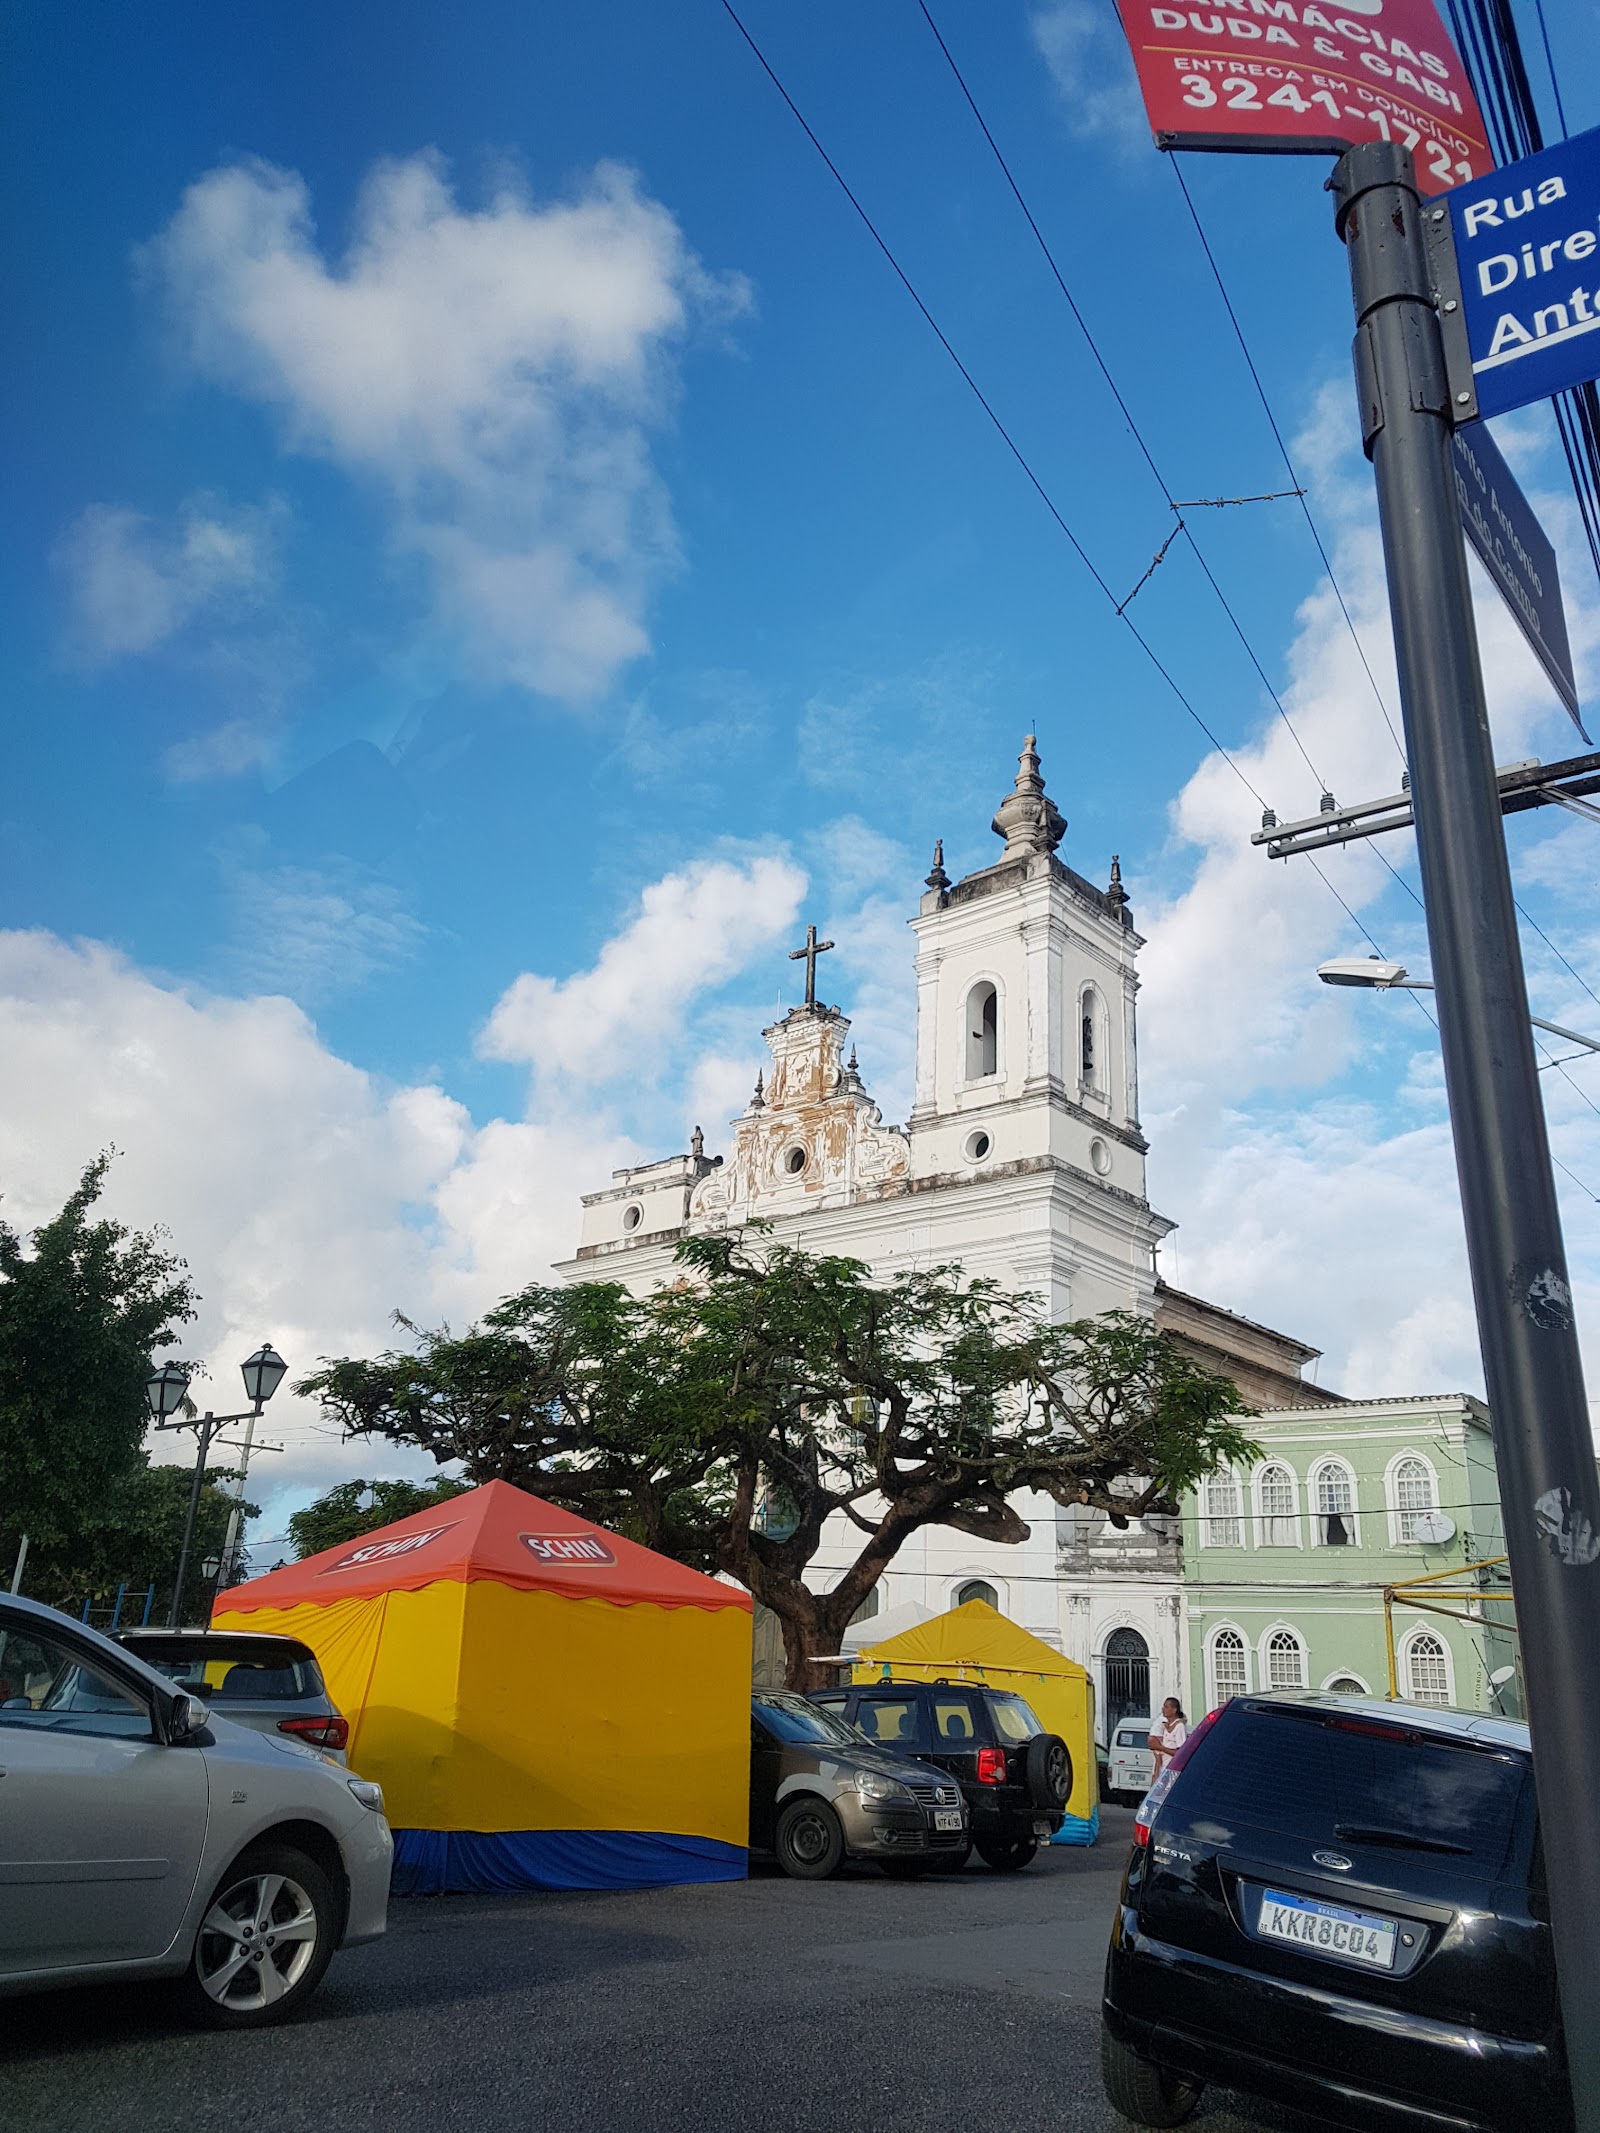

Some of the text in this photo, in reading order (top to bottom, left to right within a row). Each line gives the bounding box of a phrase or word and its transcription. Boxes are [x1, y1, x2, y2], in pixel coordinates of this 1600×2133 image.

[1150, 7, 1464, 116] DUDA & GABI
[1173, 57, 1470, 157] ENTREGA EM DOMICÍLIO
[1463, 176, 1568, 238] Rua
[1477, 214, 1600, 297] Dire
[1488, 285, 1600, 357] Ant
[1454, 430, 1487, 494] anto
[1473, 500, 1541, 634] do Carmo
[337, 1528, 446, 1567] SCHIN
[527, 1537, 609, 1560] SCHIN
[1154, 1845, 1192, 1862] FIESTA
[1271, 1906, 1379, 1960] KKR8C04
[1317, 1907, 1339, 1918] BRASIL
